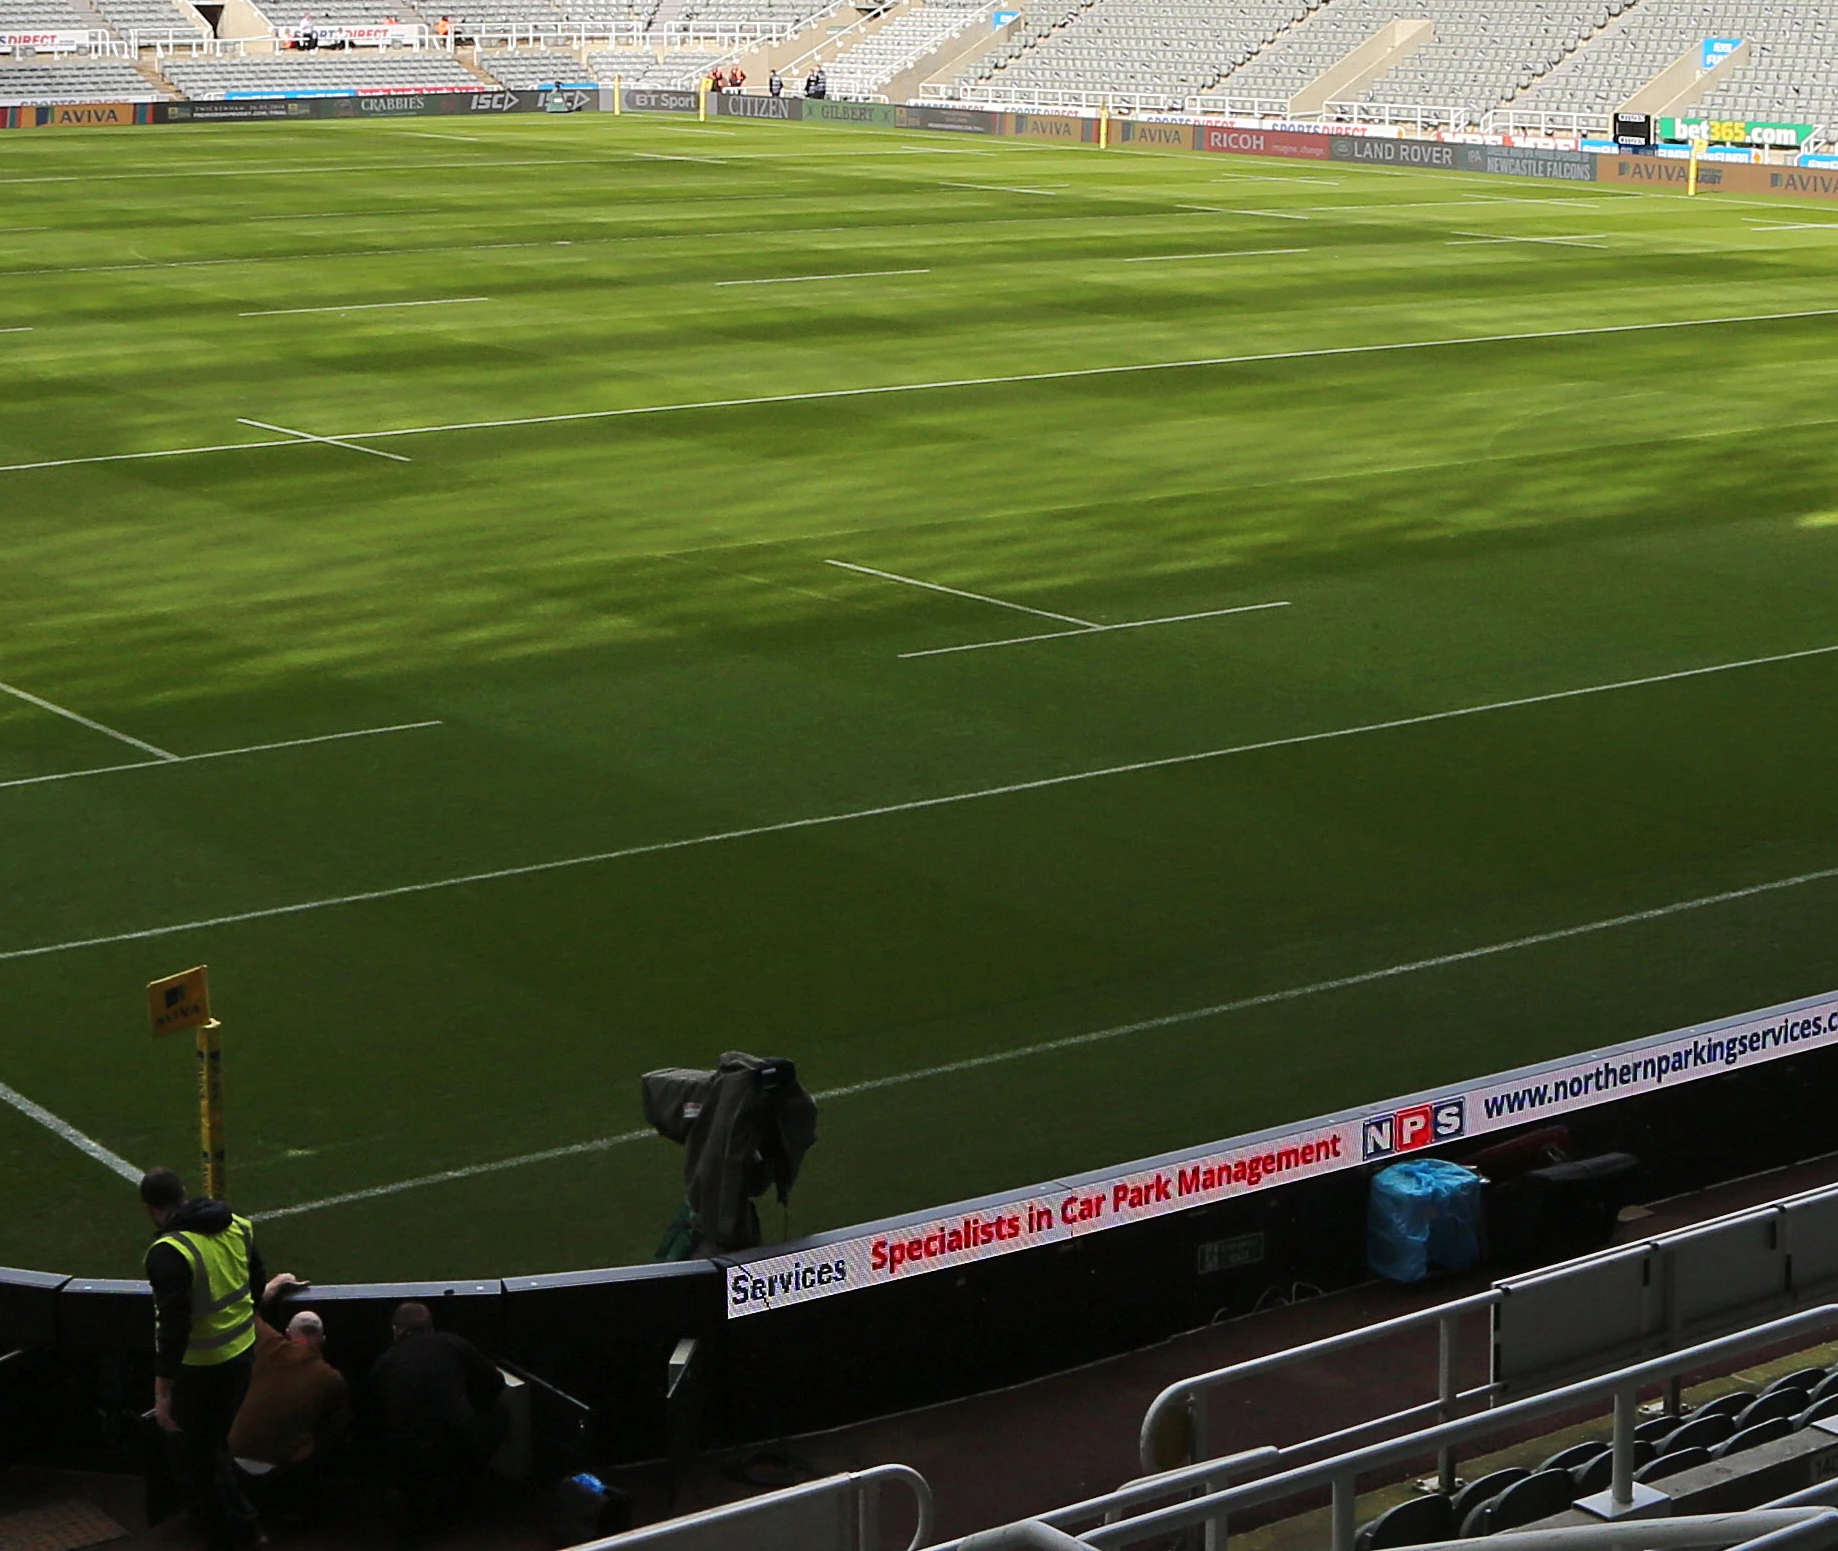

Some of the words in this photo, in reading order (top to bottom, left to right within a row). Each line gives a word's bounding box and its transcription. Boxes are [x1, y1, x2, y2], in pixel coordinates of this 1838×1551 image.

[361, 96, 425, 112] CRABBIE'S
[635, 93, 658, 106] BT
[661, 93, 696, 110] Sport
[728, 96, 789, 118] CITIZEN
[61, 108, 119, 123] AVIVA
[821, 106, 874, 122] GILBERT
[1032, 121, 1072, 136] AVIVA
[1140, 128, 1181, 144] AVIVA
[1674, 117, 1797, 145] bet365.com
[1210, 132, 1265, 151] RICOH
[1353, 142, 1394, 161] LAND
[1400, 146, 1453, 165] ROVER
[1487, 157, 1545, 177] NEWCASTLE
[1546, 162, 1591, 181] FALCONS
[1631, 162, 1687, 183] AVIVA
[1364, 1101, 1463, 1158] NPS
[730, 1259, 847, 1308] Services
[869, 1213, 1021, 1275] Specialists
[1027, 1200, 1054, 1234] in
[1060, 1192, 1107, 1225] Car
[1112, 1173, 1173, 1214] Park
[1176, 1132, 1343, 1197] Management
